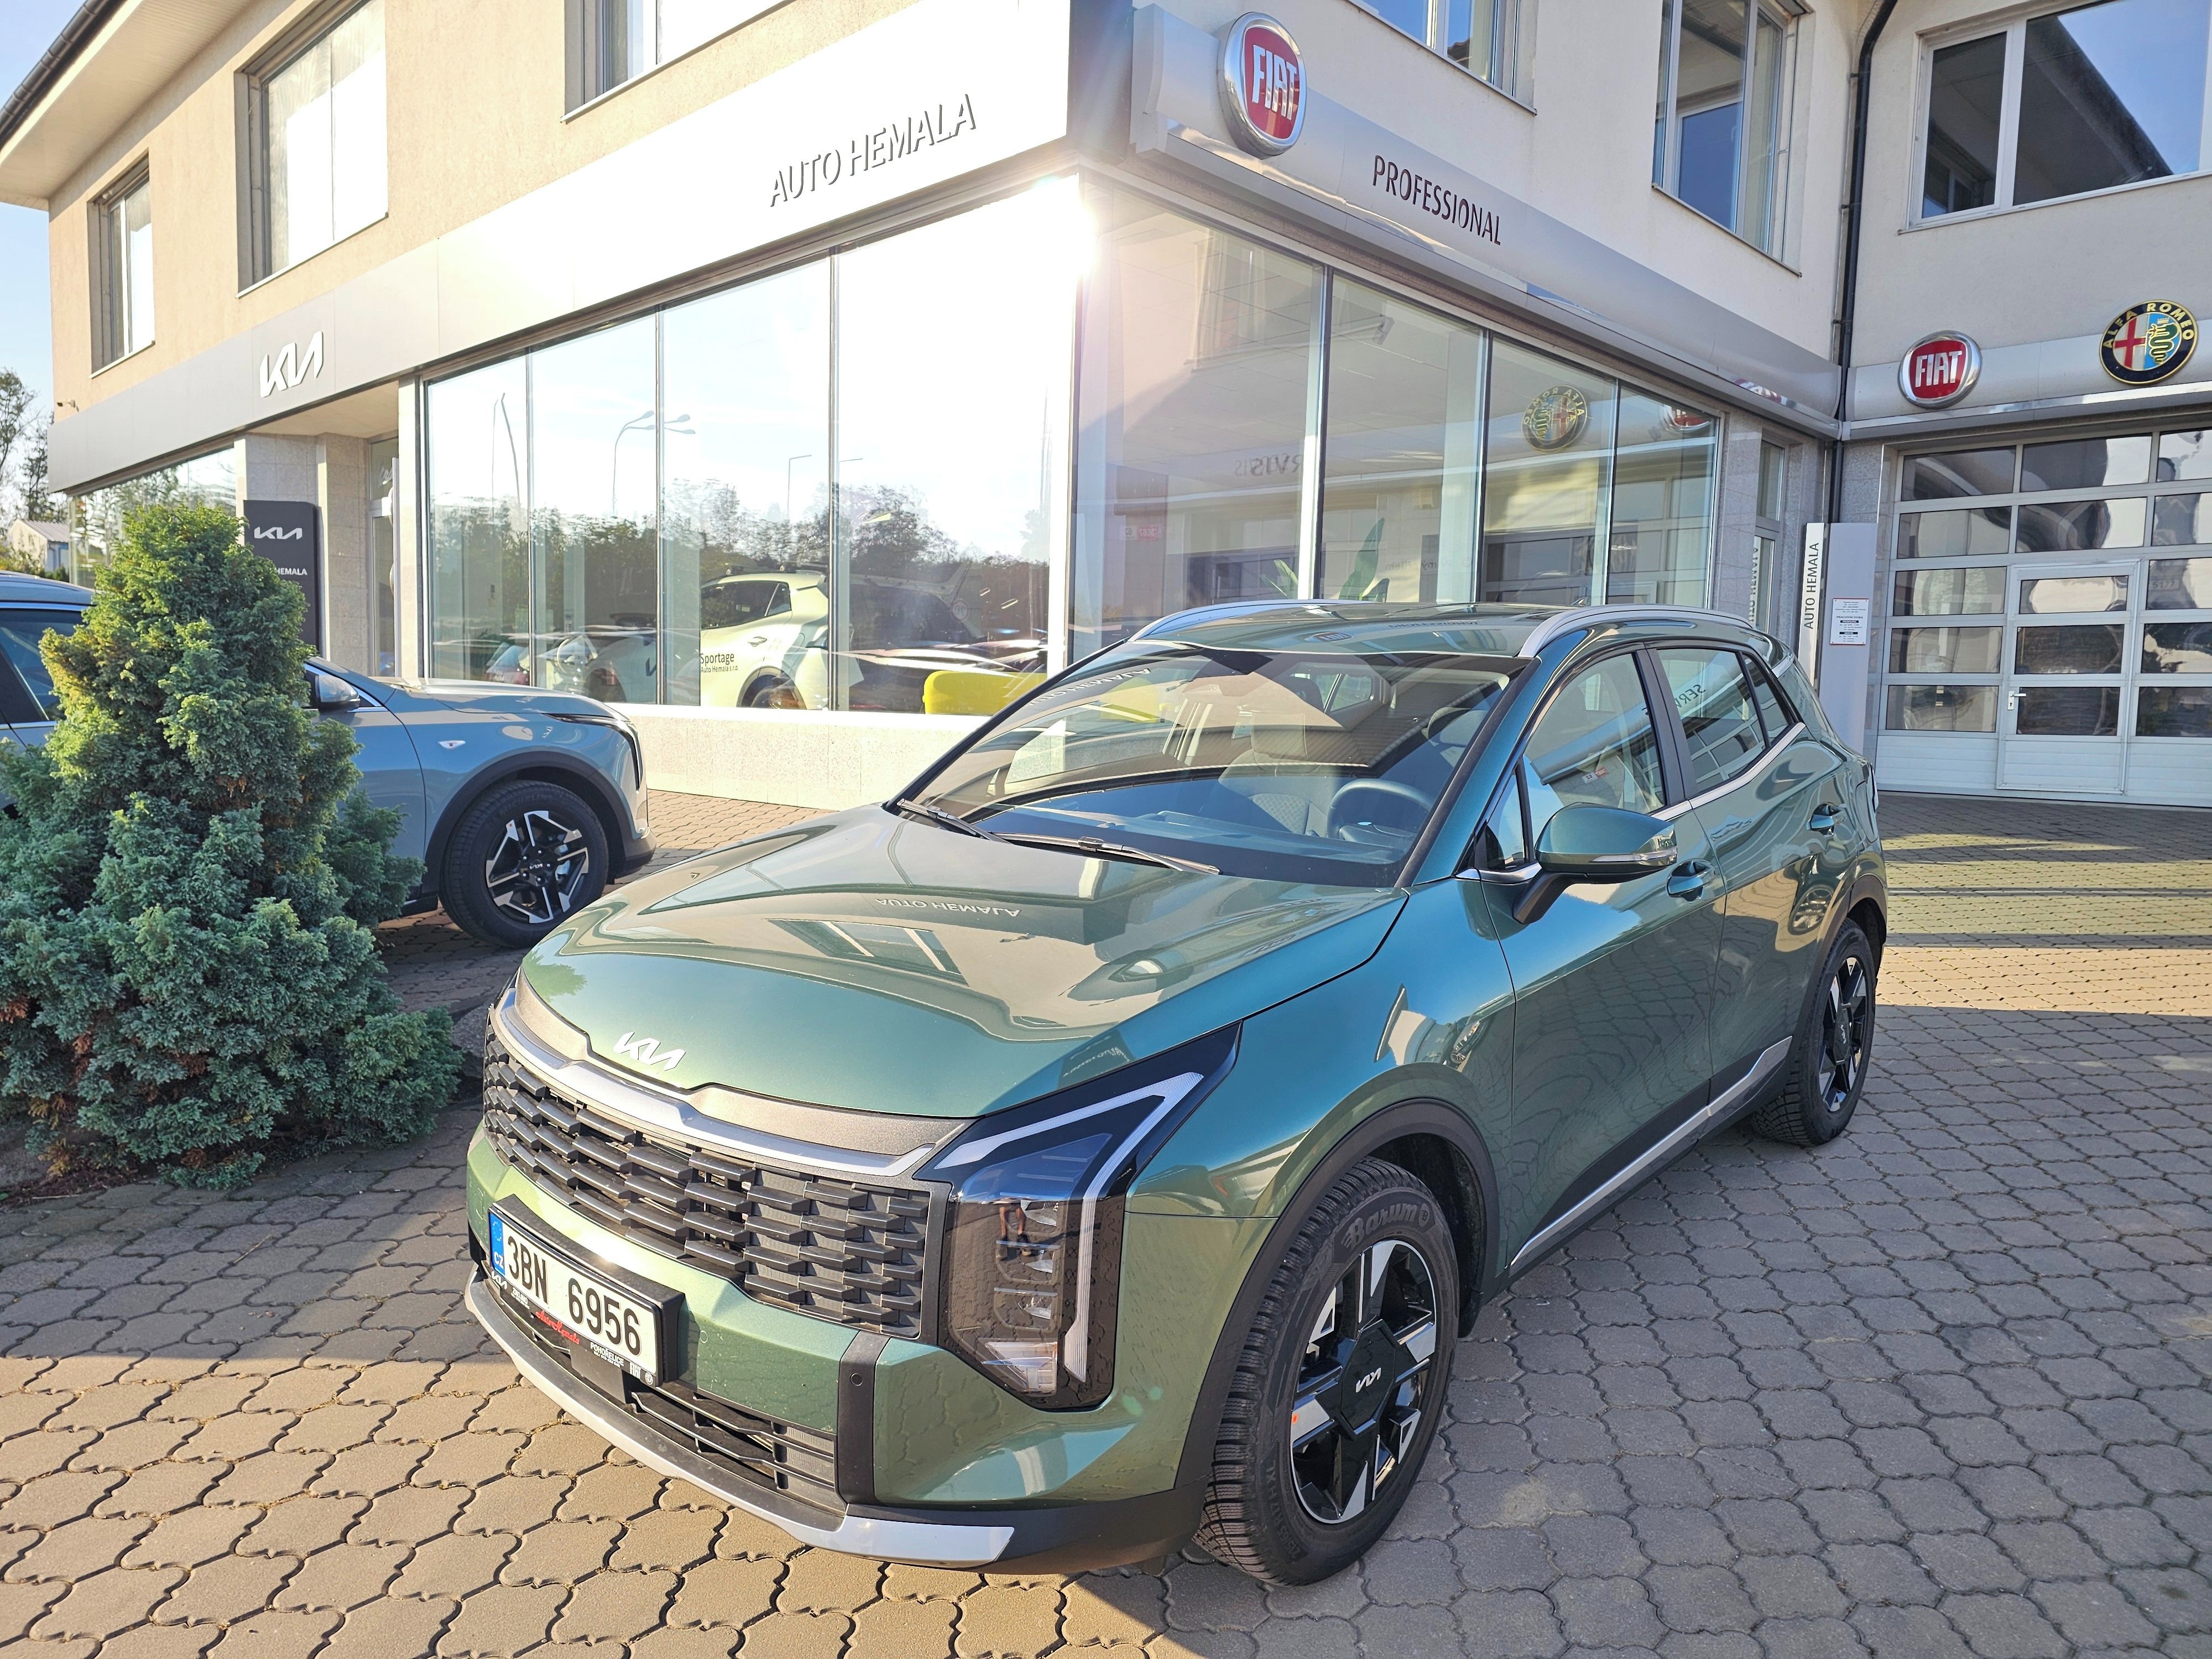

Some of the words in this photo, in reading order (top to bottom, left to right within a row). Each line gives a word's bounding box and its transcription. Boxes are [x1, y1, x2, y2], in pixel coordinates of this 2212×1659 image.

[1252, 44, 1297, 121] FIAT
[770, 149, 841, 207] AUTO
[849, 93, 976, 176] HEMALA
[1372, 154, 1501, 246] PROFESSIONAL
[2103, 310, 2137, 349] ALFA
[2146, 302, 2195, 341] ROMEO
[259, 330, 324, 398] KIA
[1914, 349, 1963, 388] FIAT
[254, 526, 303, 541] KIA
[1806, 542, 1819, 592] HEMALA
[1804, 597, 1815, 629] AUTO
[700, 653, 734, 667] Sportage
[613, 1031, 686, 1072] KIA
[1340, 1203, 1418, 1251] Barum
[494, 1251, 504, 1269] CZ
[507, 1235, 549, 1306] 3BN
[568, 1277, 640, 1357] 6956
[590, 1342, 624, 1367] POHOŘELICE
[629, 1362, 641, 1380] FIAT
